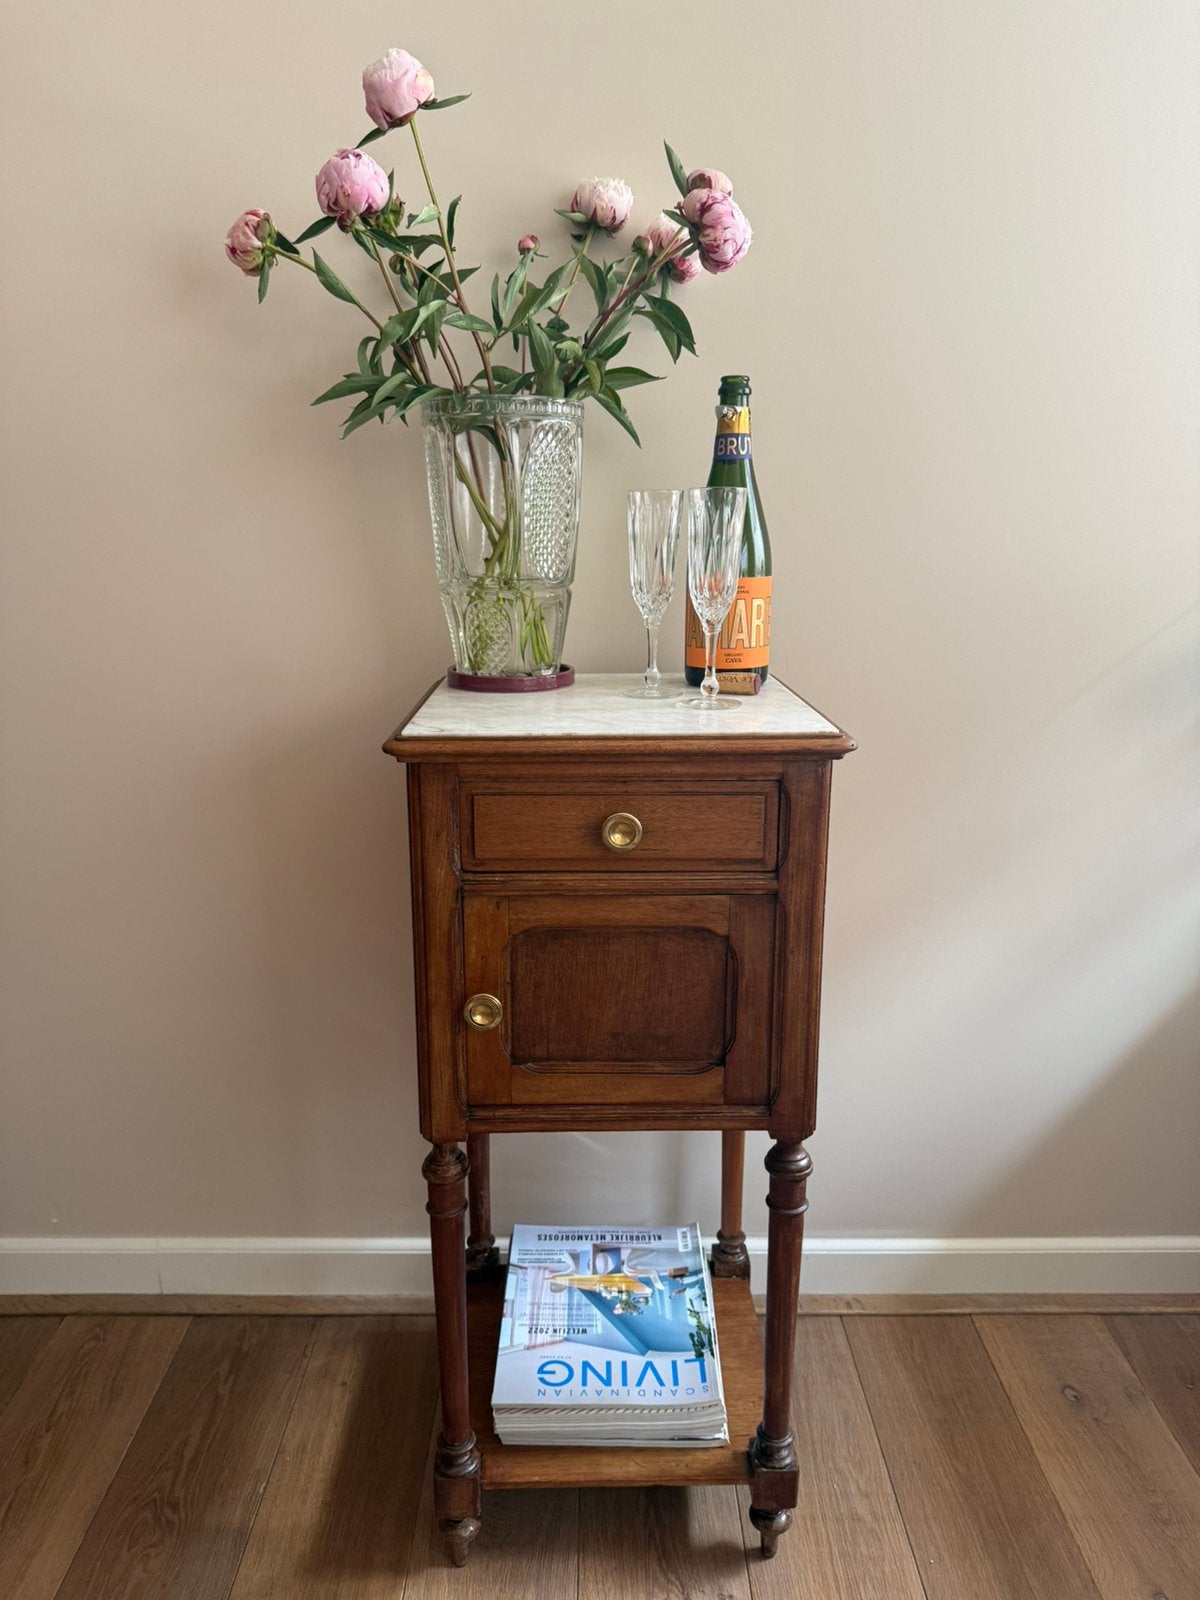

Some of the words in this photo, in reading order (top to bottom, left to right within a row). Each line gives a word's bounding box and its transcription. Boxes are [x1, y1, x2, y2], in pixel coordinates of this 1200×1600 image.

[537, 1233, 606, 1242] METAMORFOSES
[609, 1233, 662, 1242] KLEURRIJKE
[528, 1327, 550, 1335] 2022
[552, 1327, 588, 1335] WELZIJN
[536, 1358, 707, 1388] LIVING
[537, 1385, 710, 1397] SCANDINAVIAN
